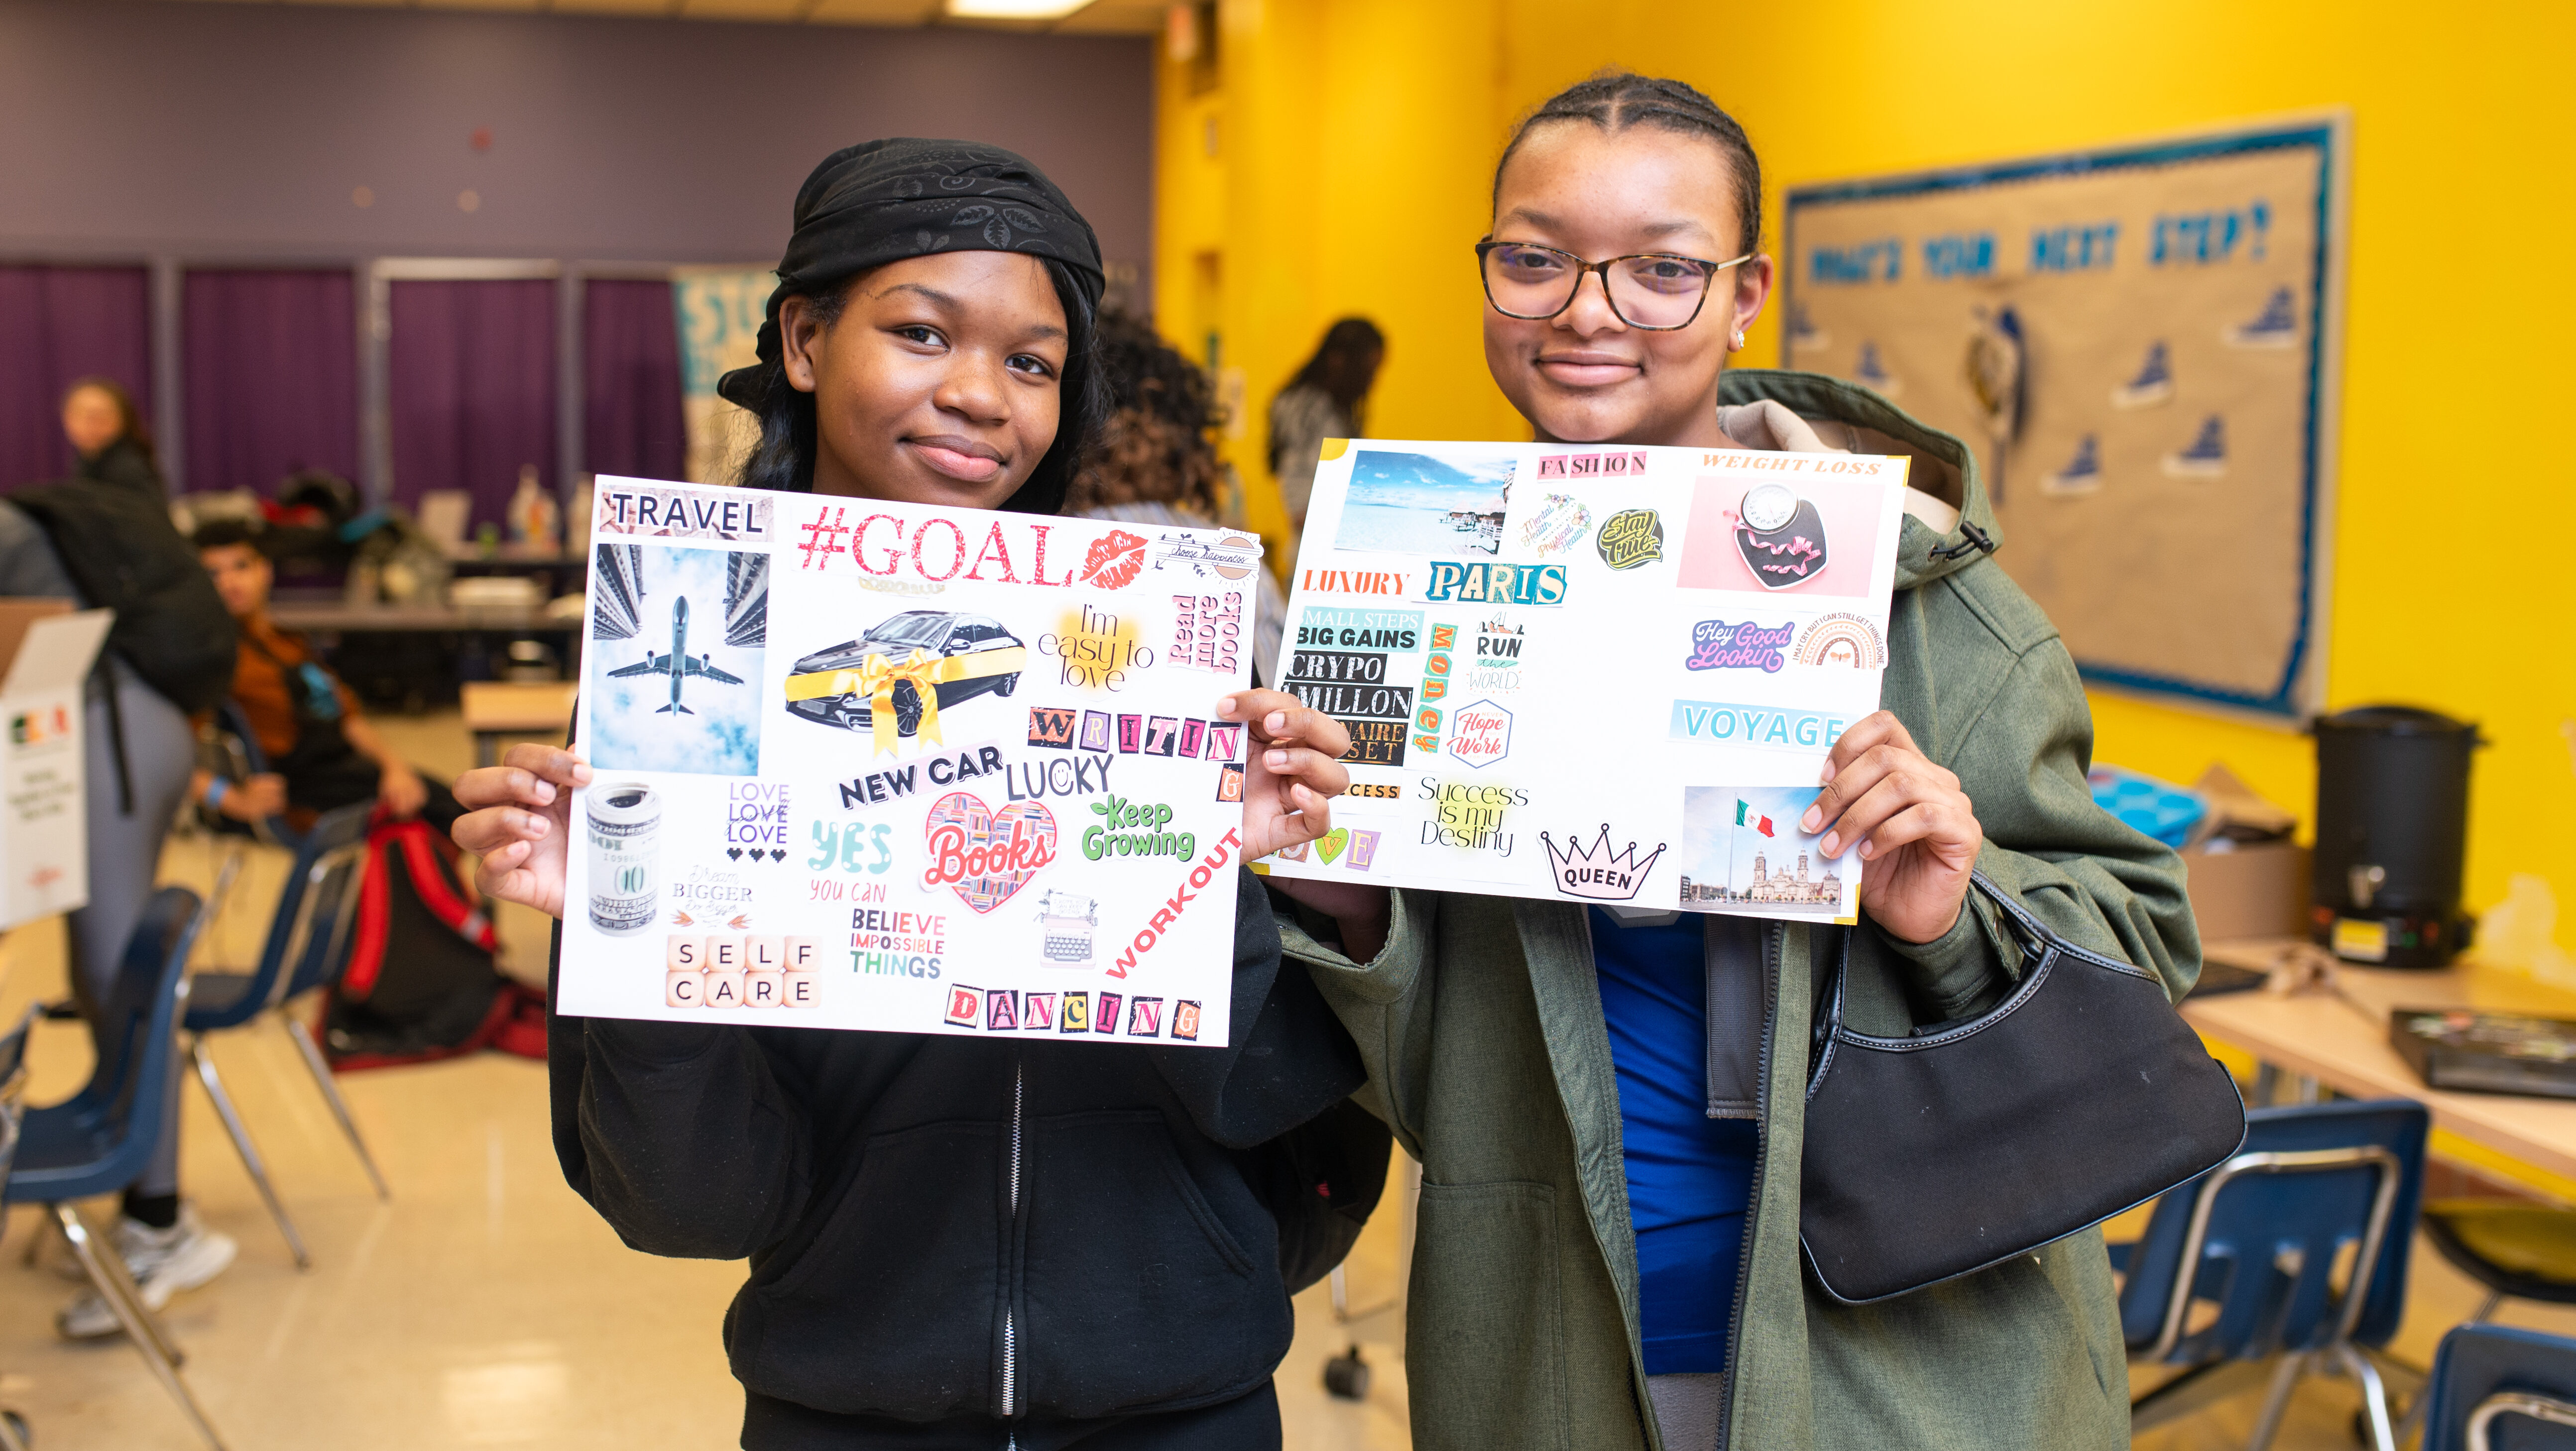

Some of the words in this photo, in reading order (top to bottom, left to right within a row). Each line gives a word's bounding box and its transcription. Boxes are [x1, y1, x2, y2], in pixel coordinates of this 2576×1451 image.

[1541, 455, 1646, 475] FASHION
[1702, 454, 1809, 471] WEIGHT
[1813, 460, 1882, 475] LOSS
[612, 493, 763, 533] TRAVEL
[1520, 505, 1554, 533] Mental
[1603, 512, 1654, 540] Stay
[798, 506, 1073, 587] #GOAL
[1521, 522, 1551, 547] Health
[1537, 524, 1573, 558] Physical
[1557, 528, 1587, 554] Health
[1171, 545, 1198, 558] choose
[1302, 569, 1410, 595] LUXURY
[1428, 563, 1566, 604] PARIS
[1081, 604, 1118, 637] I'm
[1168, 595, 1196, 666] Read
[1195, 596, 1218, 669] more
[1212, 591, 1243, 675] books
[1363, 612, 1419, 629] STEPS
[1696, 622, 1735, 646] Hey
[1736, 623, 1793, 646] Good
[1297, 627, 1334, 646] BIG
[1339, 628, 1416, 649] GAINS
[1477, 637, 1522, 658] RUN
[1793, 643, 1804, 658] MAY
[1800, 632, 1810, 644] CRY
[1807, 620, 1822, 633] BUT
[1823, 613, 1837, 622] CAN
[1837, 612, 1855, 621] STILL
[1856, 616, 1869, 626] GET
[1867, 623, 1882, 646] THINGS
[1038, 633, 1116, 671] easy
[1126, 640, 1154, 669] to
[1475, 659, 1520, 668] the
[1688, 642, 1782, 671] Lookin
[1060, 655, 1125, 692] love
[1287, 653, 1382, 681] CRYPO
[1470, 671, 1519, 689] WORLD
[1296, 685, 1412, 716] MILLON
[1458, 713, 1506, 741] Hope
[1685, 707, 1844, 747] VOYAGE
[1446, 737, 1502, 755] Work
[839, 765, 917, 810] NEW
[929, 746, 1004, 786] CAR
[1006, 753, 1114, 801] LUCKY
[1339, 783, 1398, 798] CESS
[730, 782, 789, 802] LOVE
[1418, 777, 1528, 806] Success
[729, 803, 788, 823] LOVE
[1106, 794, 1173, 833] Keep
[1437, 801, 1457, 824] is
[1465, 807, 1504, 832] my
[728, 824, 788, 843] LOVE
[1082, 825, 1195, 862] Growing
[1421, 820, 1514, 858] Destiny
[925, 820, 1056, 885] Books
[689, 865, 740, 885] Dream
[1564, 868, 1632, 890] QUEEN
[672, 883, 753, 902] BIGGER
[852, 908, 946, 936] BELIEVE
[679, 944, 812, 964] SELF
[850, 933, 945, 955] IMPOSSIBLE
[850, 950, 941, 979] THINGS
[676, 980, 810, 1001] CARE
[947, 988, 1199, 1037] DANCING
